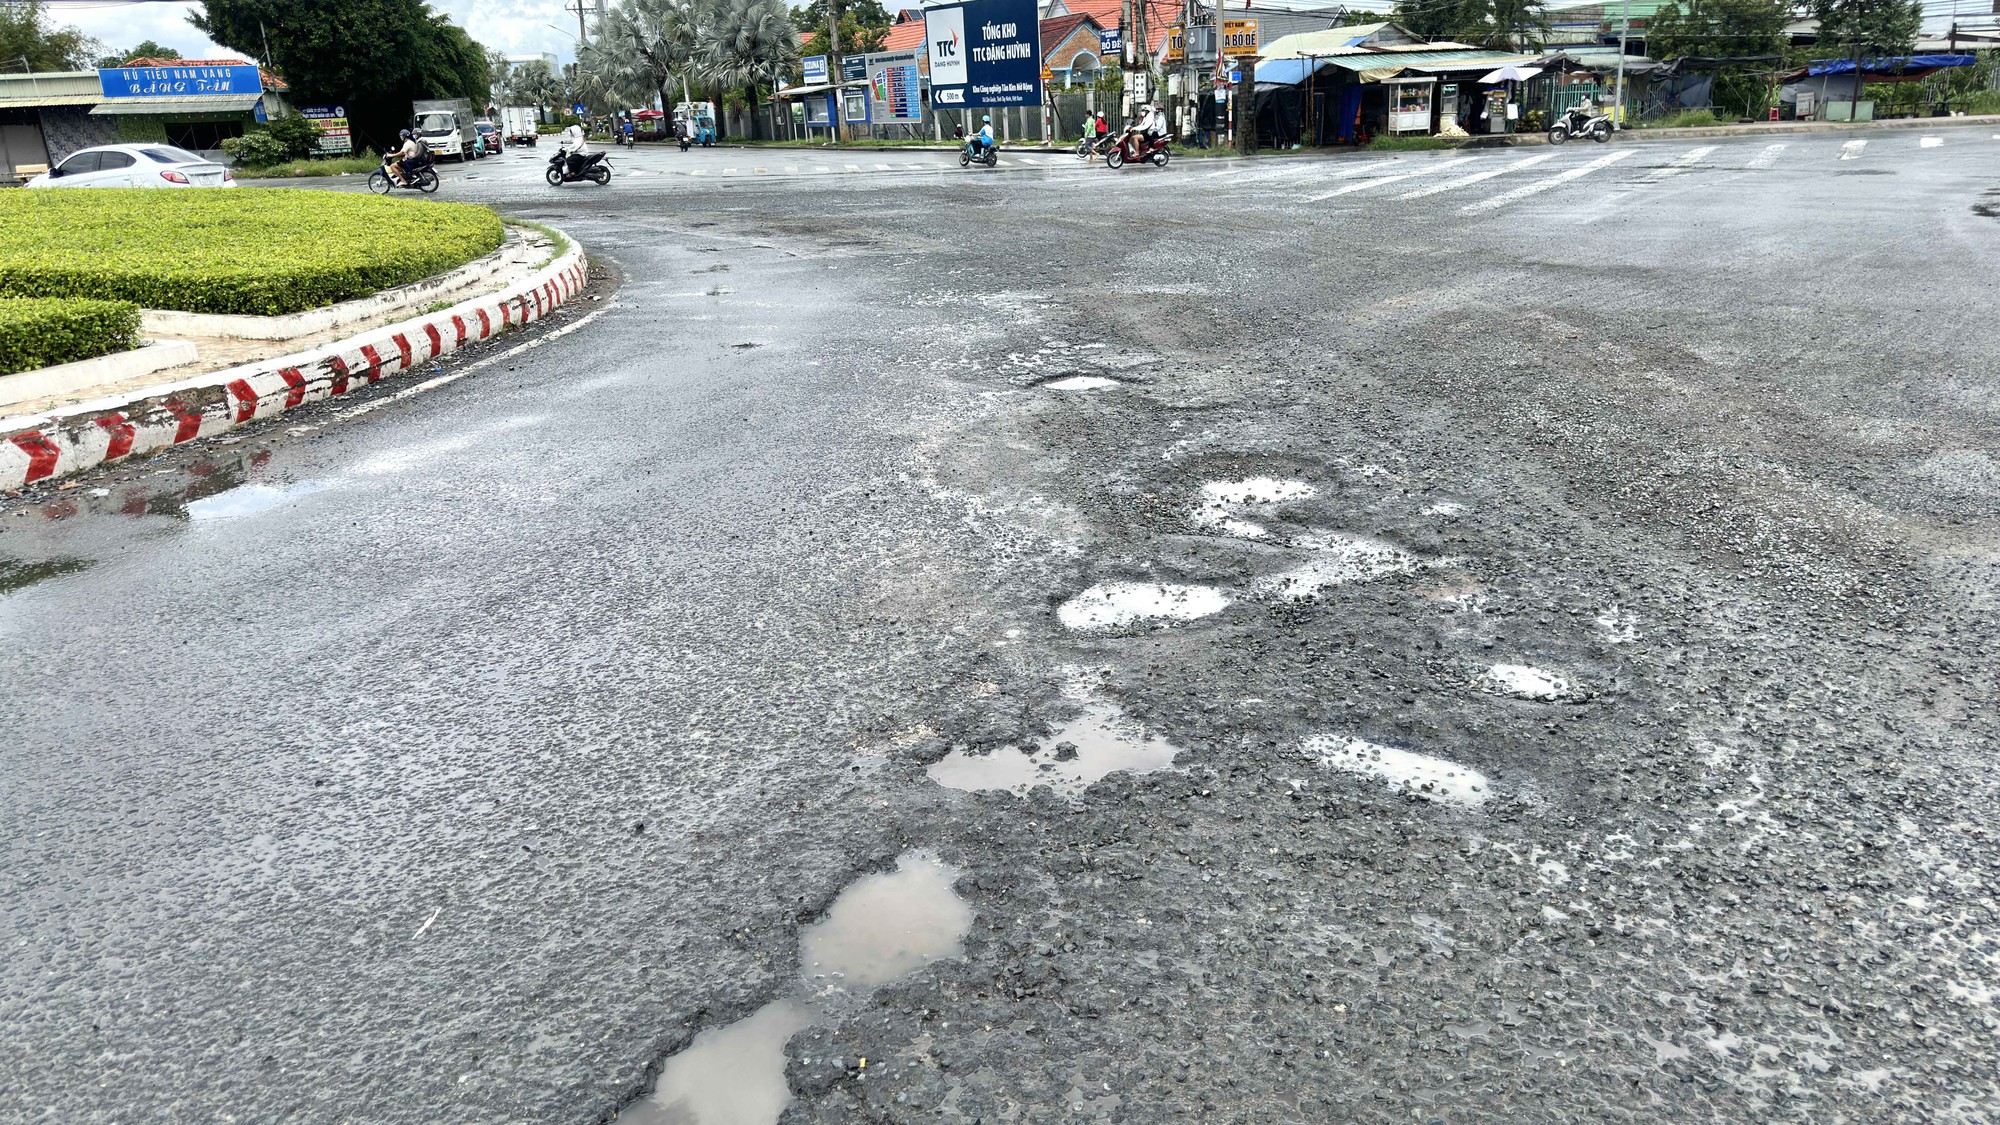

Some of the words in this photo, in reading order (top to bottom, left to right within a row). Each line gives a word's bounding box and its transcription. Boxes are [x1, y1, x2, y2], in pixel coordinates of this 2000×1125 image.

[982, 20, 1001, 40] TỔNG
[1002, 22, 1017, 38] KHO
[937, 40, 955, 57] TTC
[972, 47, 986, 62] TTC
[986, 43, 1005, 65] ĐẶNG
[1006, 41, 1031, 60] HUỲNH
[123, 68, 138, 80] HỦ
[145, 67, 168, 80] TIẾU
[174, 69, 196, 79] NAM
[202, 68, 231, 78] VANG
[946, 92, 954, 100] 500
